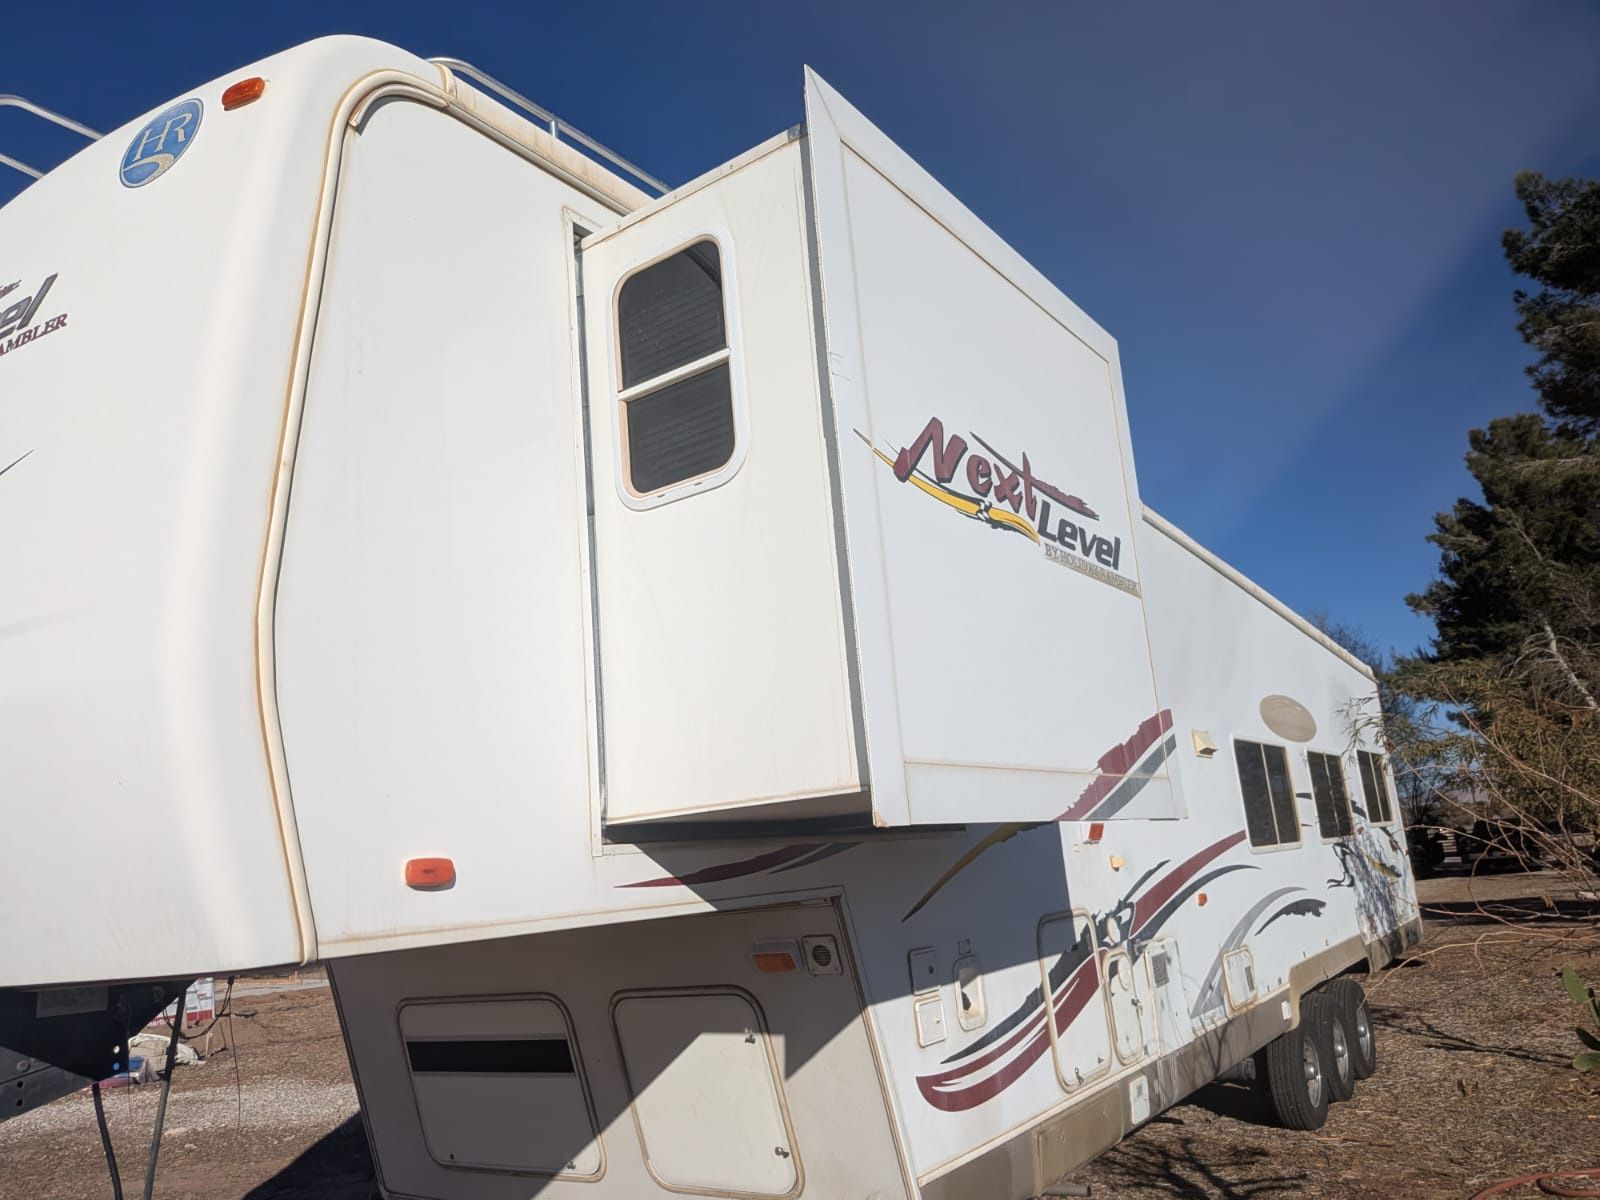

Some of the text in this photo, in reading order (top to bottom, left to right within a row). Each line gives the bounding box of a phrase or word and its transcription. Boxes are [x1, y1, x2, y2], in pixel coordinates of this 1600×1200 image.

[132, 112, 193, 162] HR
[893, 416, 1099, 521] Next
[1037, 500, 1121, 570] Level
